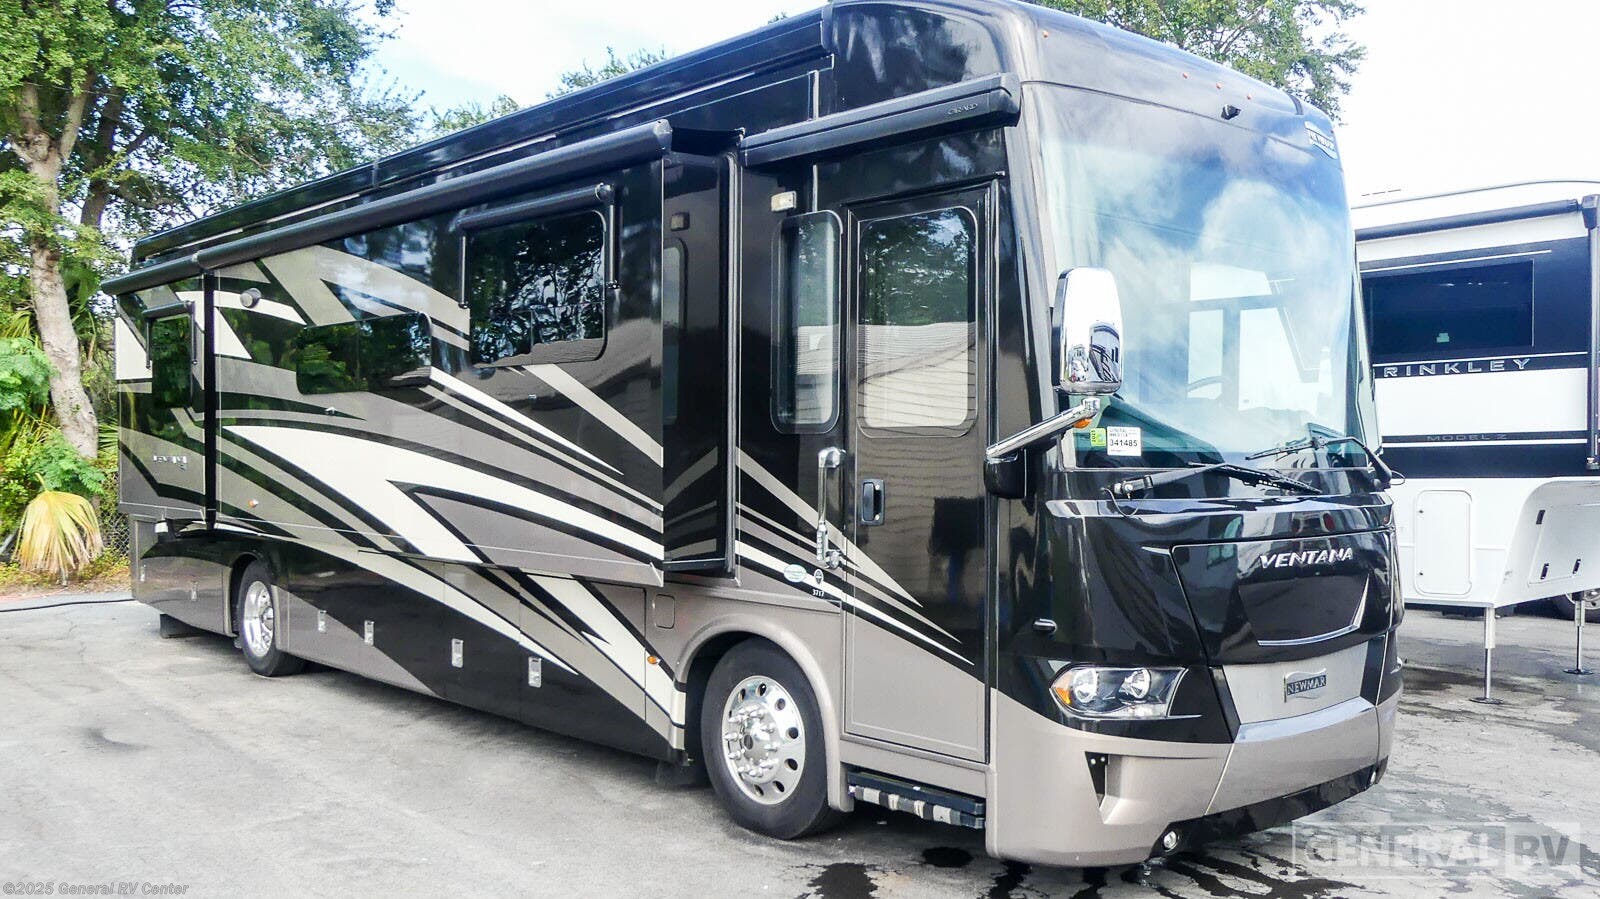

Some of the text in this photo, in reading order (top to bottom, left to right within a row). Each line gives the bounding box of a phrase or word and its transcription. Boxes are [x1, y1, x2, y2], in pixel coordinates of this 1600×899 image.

[1383, 358, 1530, 377] RINKLEY
[1109, 439, 1138, 447] 341485
[1427, 433, 1490, 441] MODEL
[1260, 547, 1353, 568] VENTANA
[1287, 675, 1327, 695] NEWMAR
